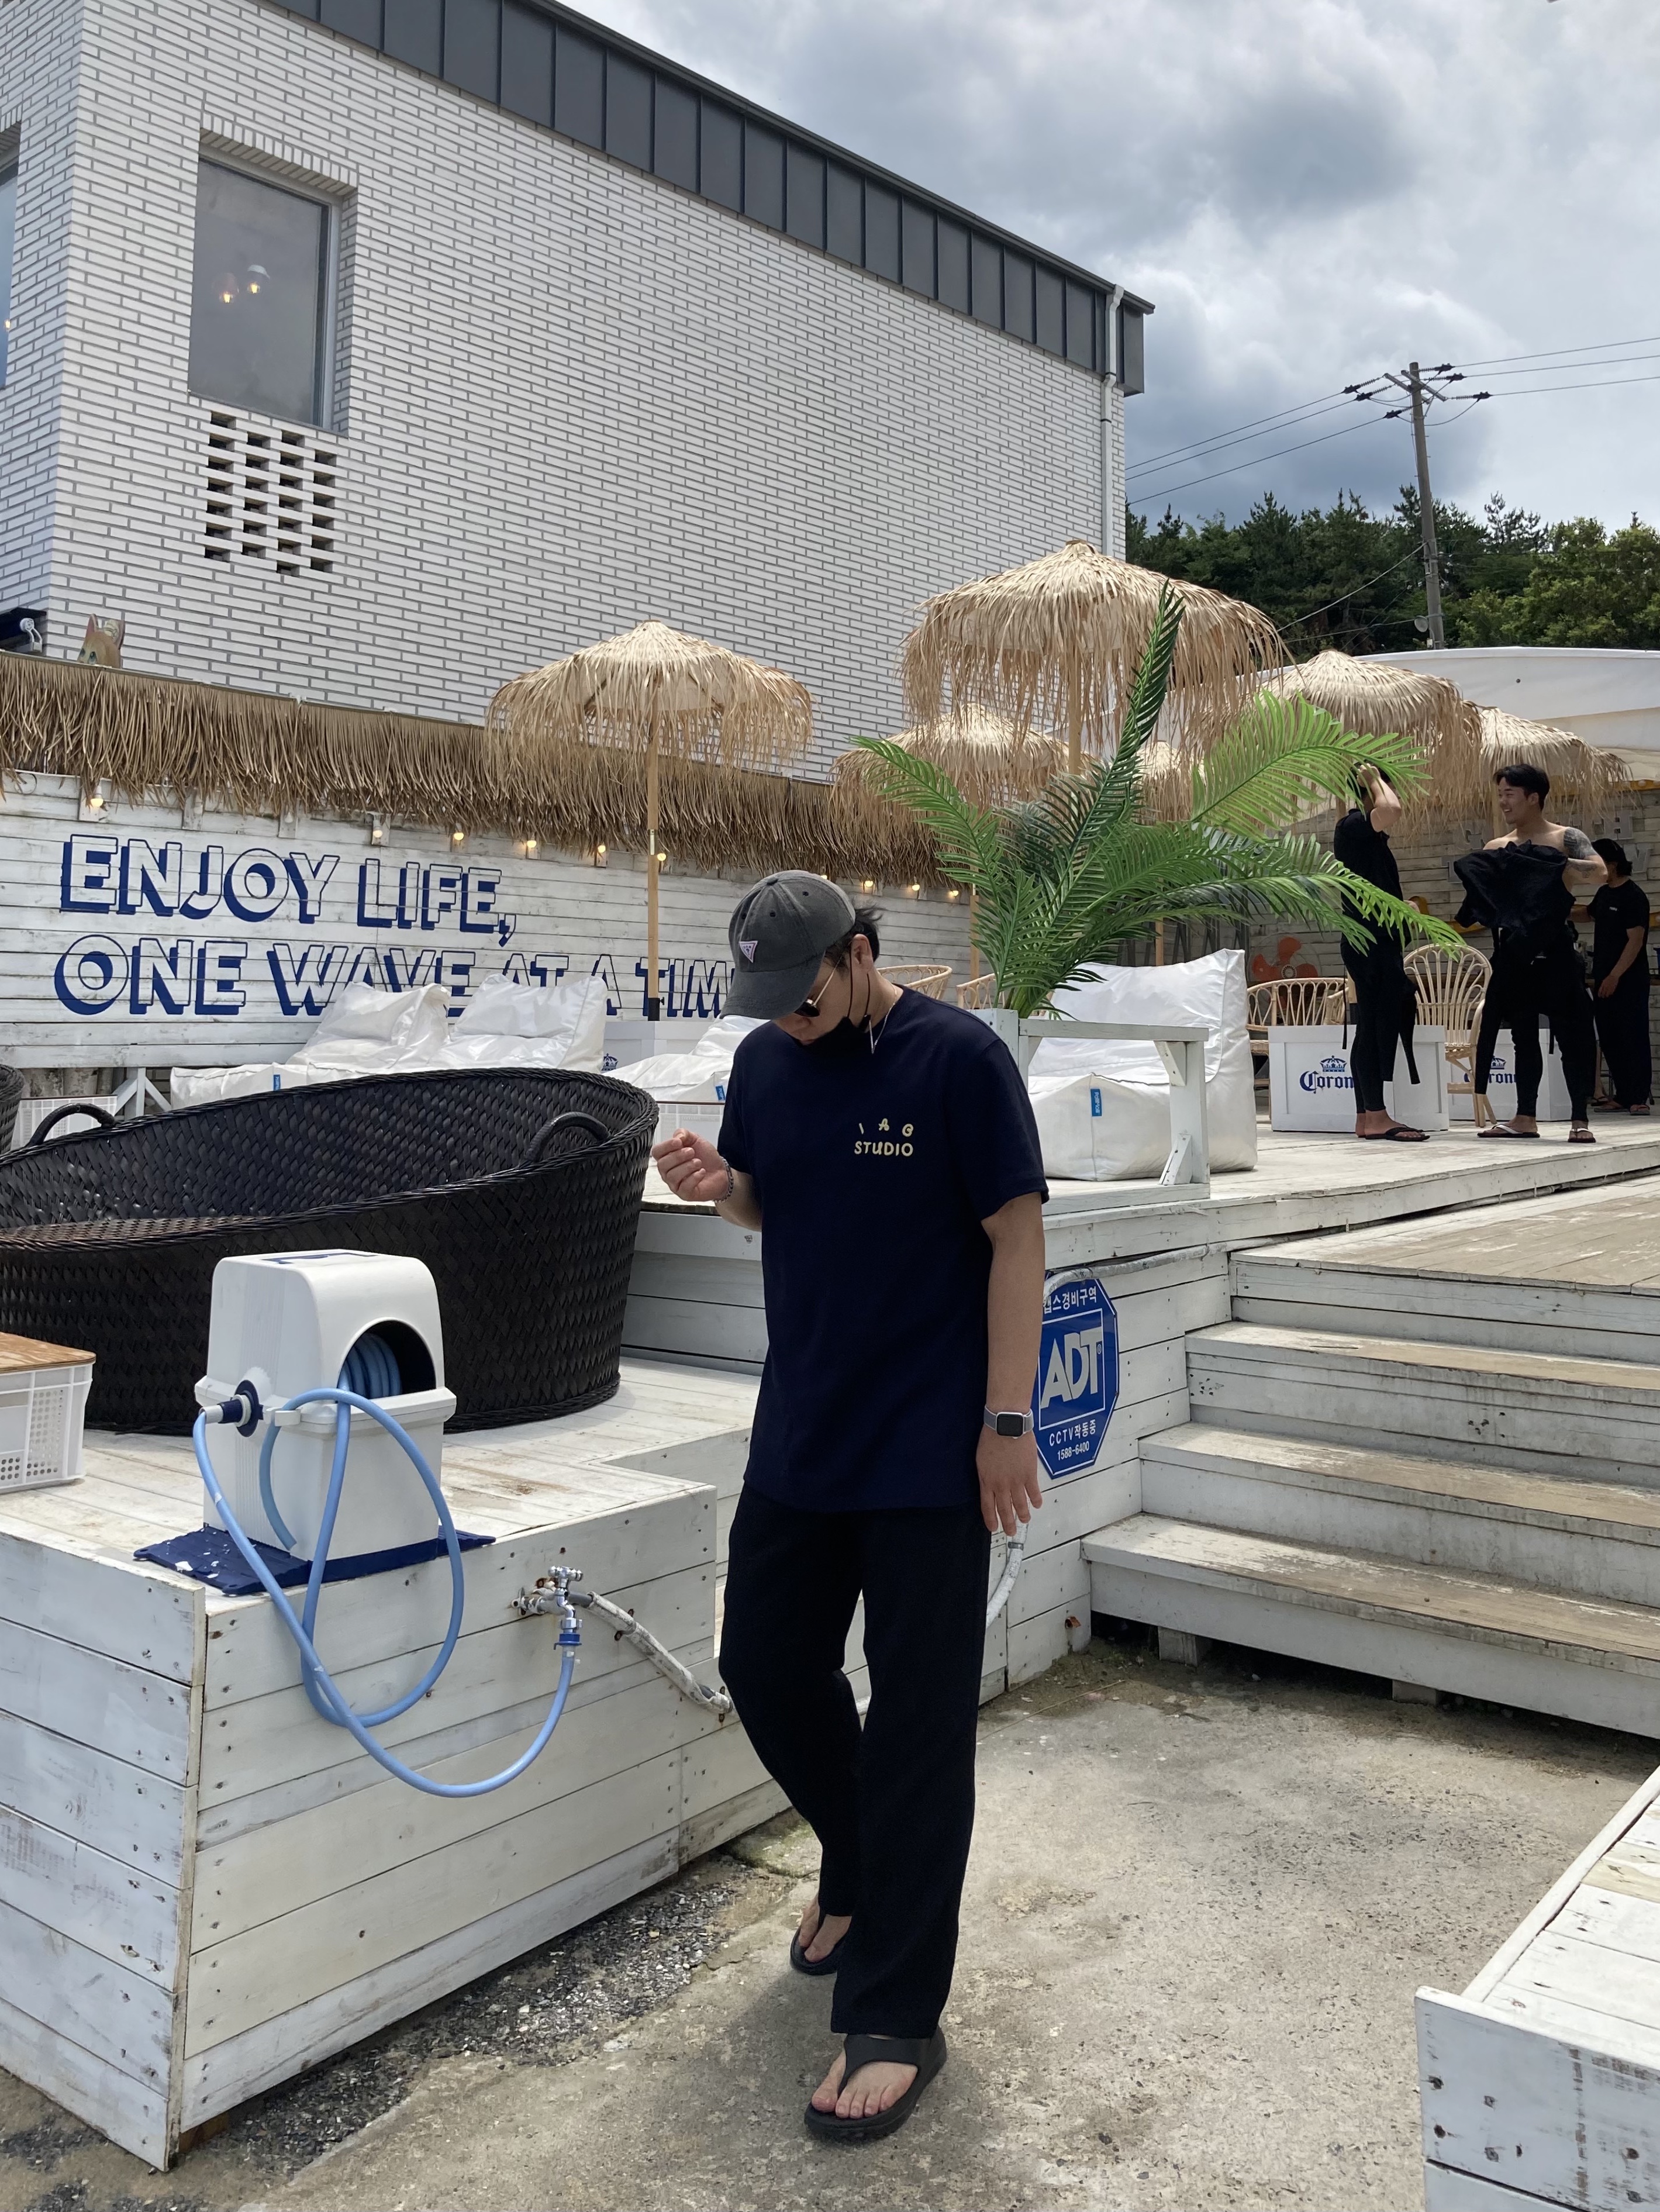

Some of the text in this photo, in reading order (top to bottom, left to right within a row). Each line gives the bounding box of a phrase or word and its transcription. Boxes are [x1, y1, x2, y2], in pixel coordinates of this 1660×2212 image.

[61, 833, 516, 947] ENJOY LIFE,
[54, 934, 248, 1015] ONE
[635, 956, 735, 1019] TIM
[1300, 1070, 1355, 1094] Coron
[854, 1141, 913, 1157] STUDIO
[1040, 1326, 1103, 1409] ADT
[1057, 1440, 1090, 1461] 1588-6400
